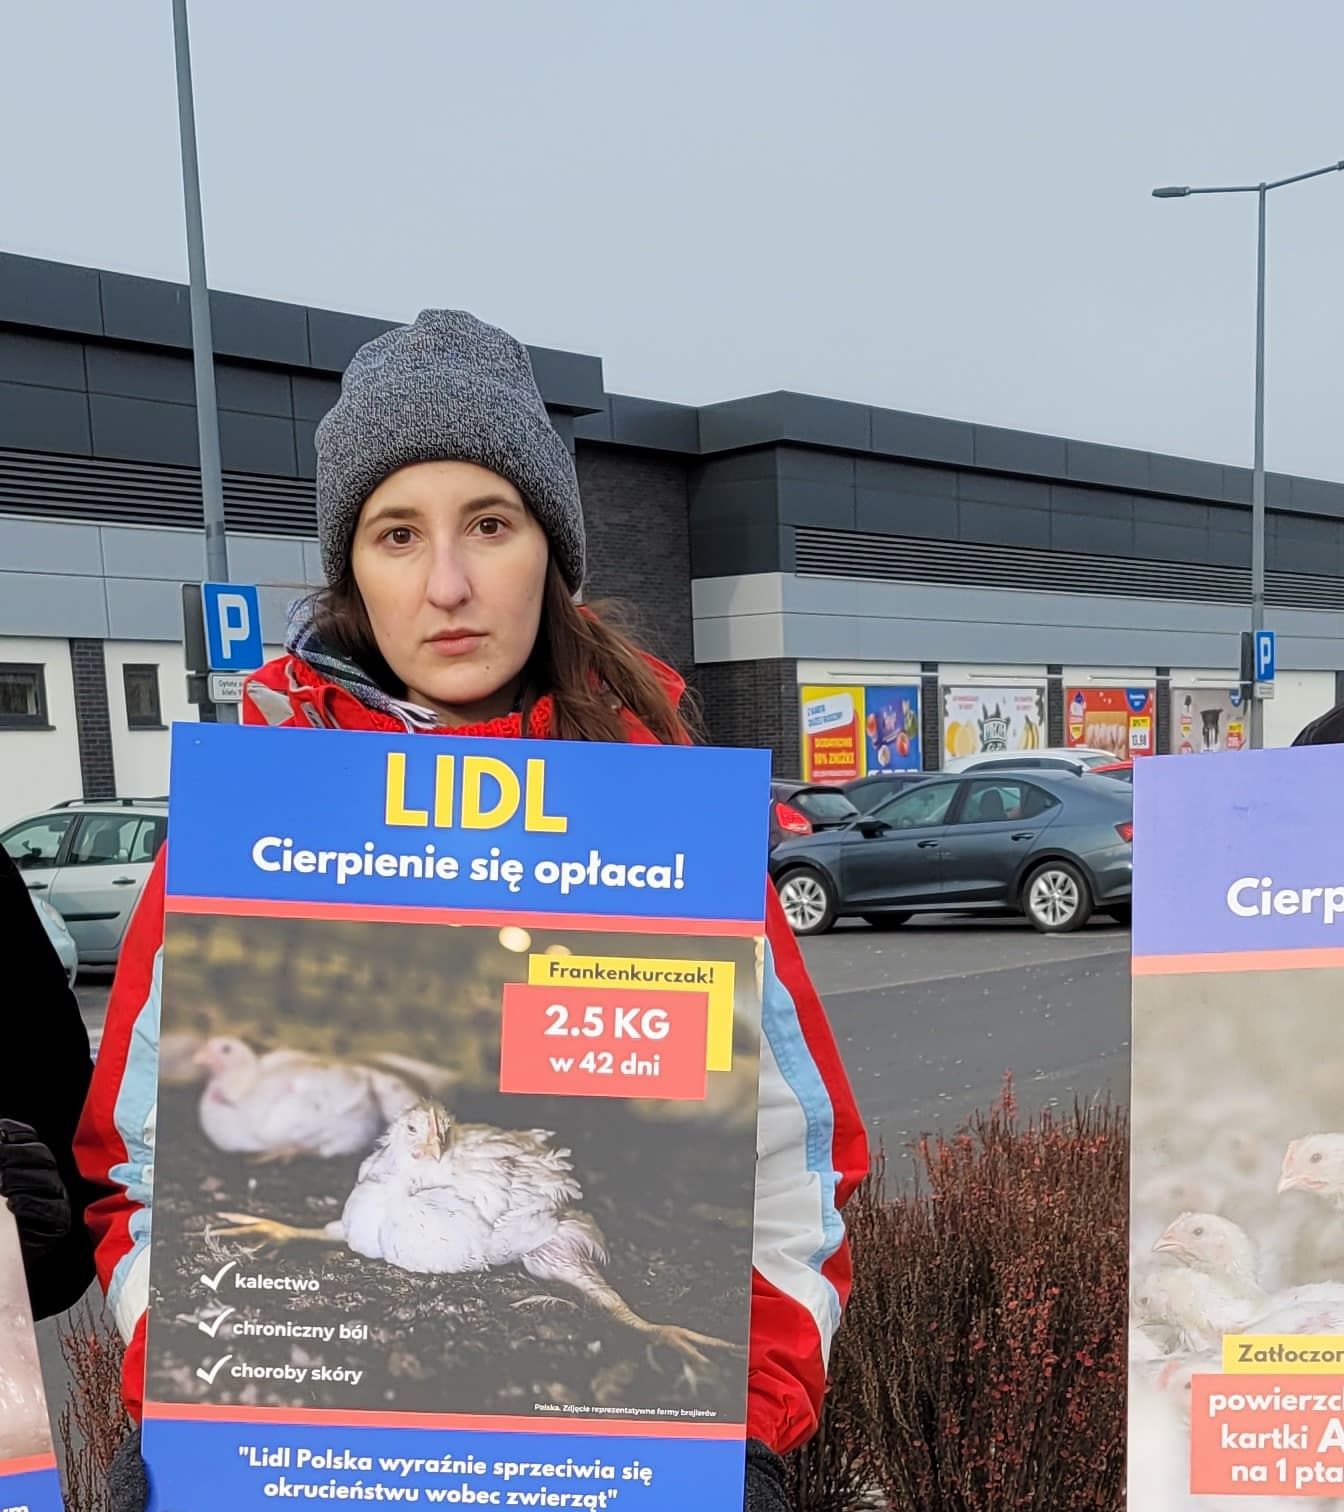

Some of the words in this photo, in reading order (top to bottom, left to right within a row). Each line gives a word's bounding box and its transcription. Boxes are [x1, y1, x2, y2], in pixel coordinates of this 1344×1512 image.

[217, 593, 250, 660] P
[1260, 637, 1271, 675] P
[385, 752, 568, 833] LIDL
[251, 836, 460, 885] Cierpienie
[469, 848, 524, 893] się
[534, 850, 685, 894] opłaca!
[548, 961, 715, 985] Frankenkurczak!
[544, 1005, 605, 1039] 2.5
[614, 1008, 671, 1040] KG
[549, 1056, 576, 1074] w
[579, 1052, 614, 1075] 42
[621, 1053, 660, 1077] dni
[235, 1273, 321, 1292] kalectwo
[232, 1321, 336, 1342] chroniczny
[339, 1324, 369, 1341] ból
[230, 1363, 307, 1383] choroby
[311, 1365, 363, 1385] skóry
[1221, 1423, 1309, 1449] kartki
[238, 1446, 290, 1468] "Lidl
[297, 1448, 373, 1471] Polska
[378, 1454, 487, 1477] wyraźnie
[492, 1458, 615, 1481] sprzeciwia
[621, 1460, 653, 1485] się
[1231, 1463, 1268, 1482] na
[1275, 1458, 1288, 1482] 1
[263, 1476, 419, 1502] okrucieństwu
[425, 1484, 501, 1505] wobec
[506, 1486, 618, 1512] zwierząt"
